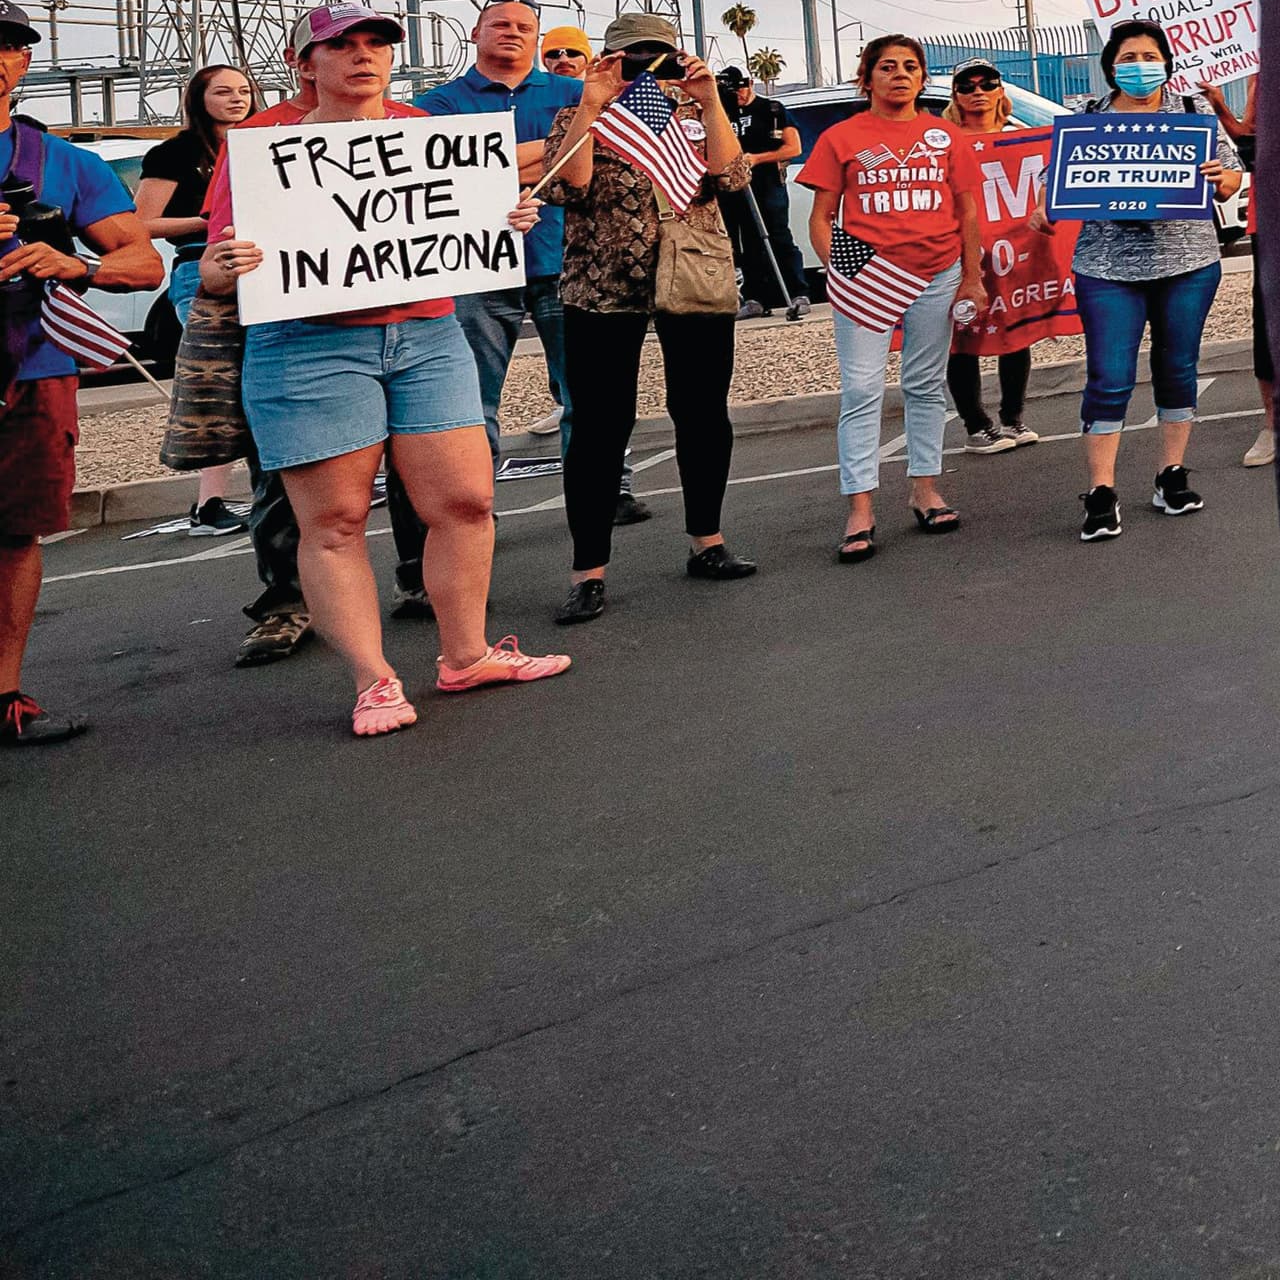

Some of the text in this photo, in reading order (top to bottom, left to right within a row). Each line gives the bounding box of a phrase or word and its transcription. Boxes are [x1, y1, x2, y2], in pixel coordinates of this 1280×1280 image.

[1165, 0, 1258, 56] RRUPT
[1171, 43, 1243, 73] ALS WITH
[269, 131, 511, 190] FREE OUR
[1068, 143, 1197, 162] ASSYRIANS
[858, 167, 945, 185] ASSYRIANS
[1070, 170, 1191, 184] FOR TRUMP
[332, 179, 461, 233] VOTE
[1108, 201, 1148, 210] 2020
[278, 229, 519, 295] IN ARIZONA
[1010, 277, 1076, 308] GREA
